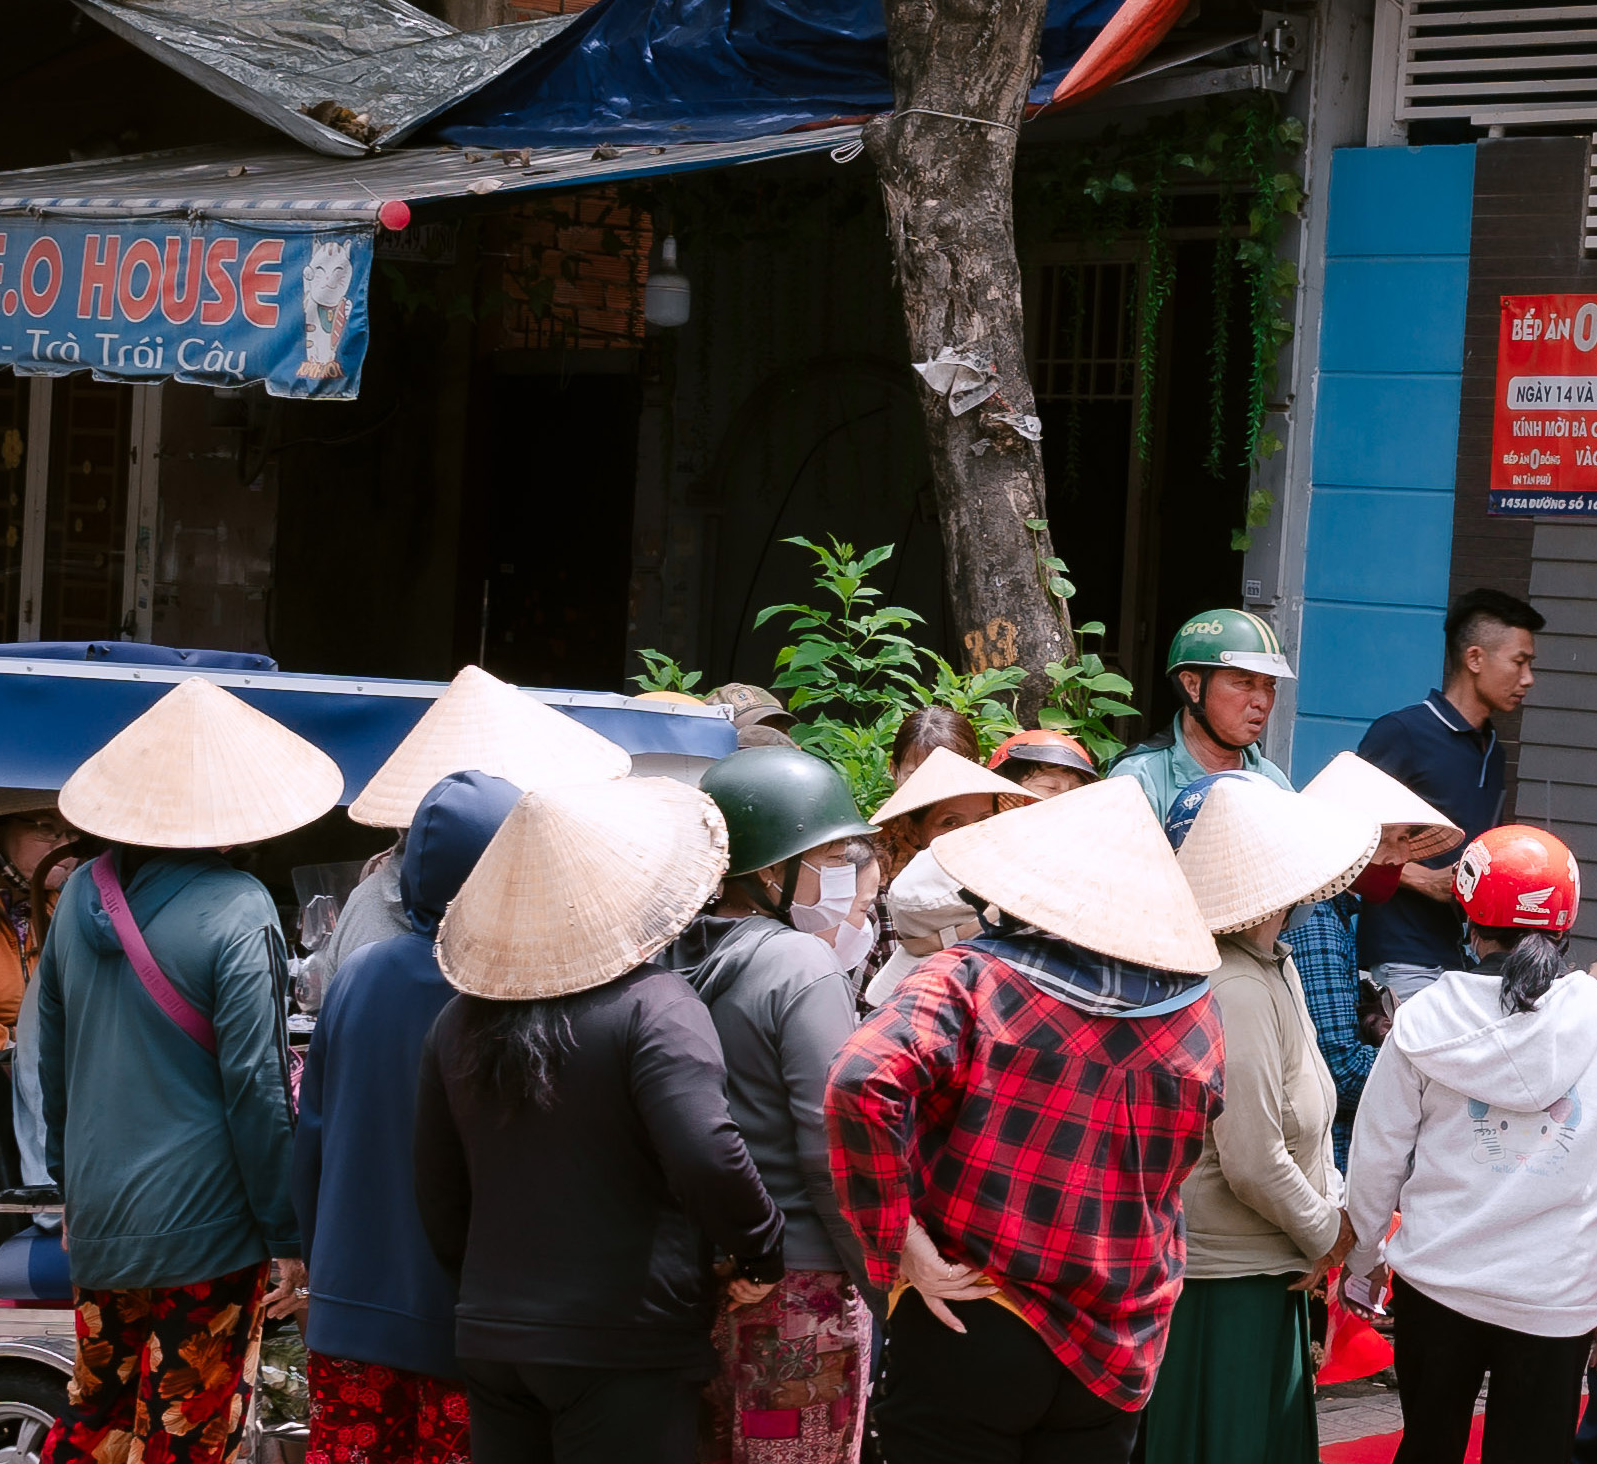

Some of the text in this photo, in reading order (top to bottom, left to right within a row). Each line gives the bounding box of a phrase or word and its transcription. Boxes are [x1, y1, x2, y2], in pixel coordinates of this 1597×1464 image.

[76, 232, 286, 329] HOUSE
[1512, 307, 1541, 340] BẾP
[1544, 313, 1570, 340] ĂN
[25, 329, 80, 364] Trà
[95, 330, 165, 372] Trái
[176, 337, 248, 382] Cây
[1516, 381, 1551, 404] NGÀY
[1556, 386, 1572, 403] 14
[1577, 381, 1594, 403] VÀ
[1512, 416, 1542, 436] KÍNH
[1545, 416, 1569, 438] MỜI
[1573, 416, 1587, 437] BÀ
[1529, 497, 1566, 510] ĐƯỜNG
[1568, 495, 1584, 510] SỐ
[1180, 620, 1223, 636] Grab
[1516, 905, 1550, 914] HONDA
